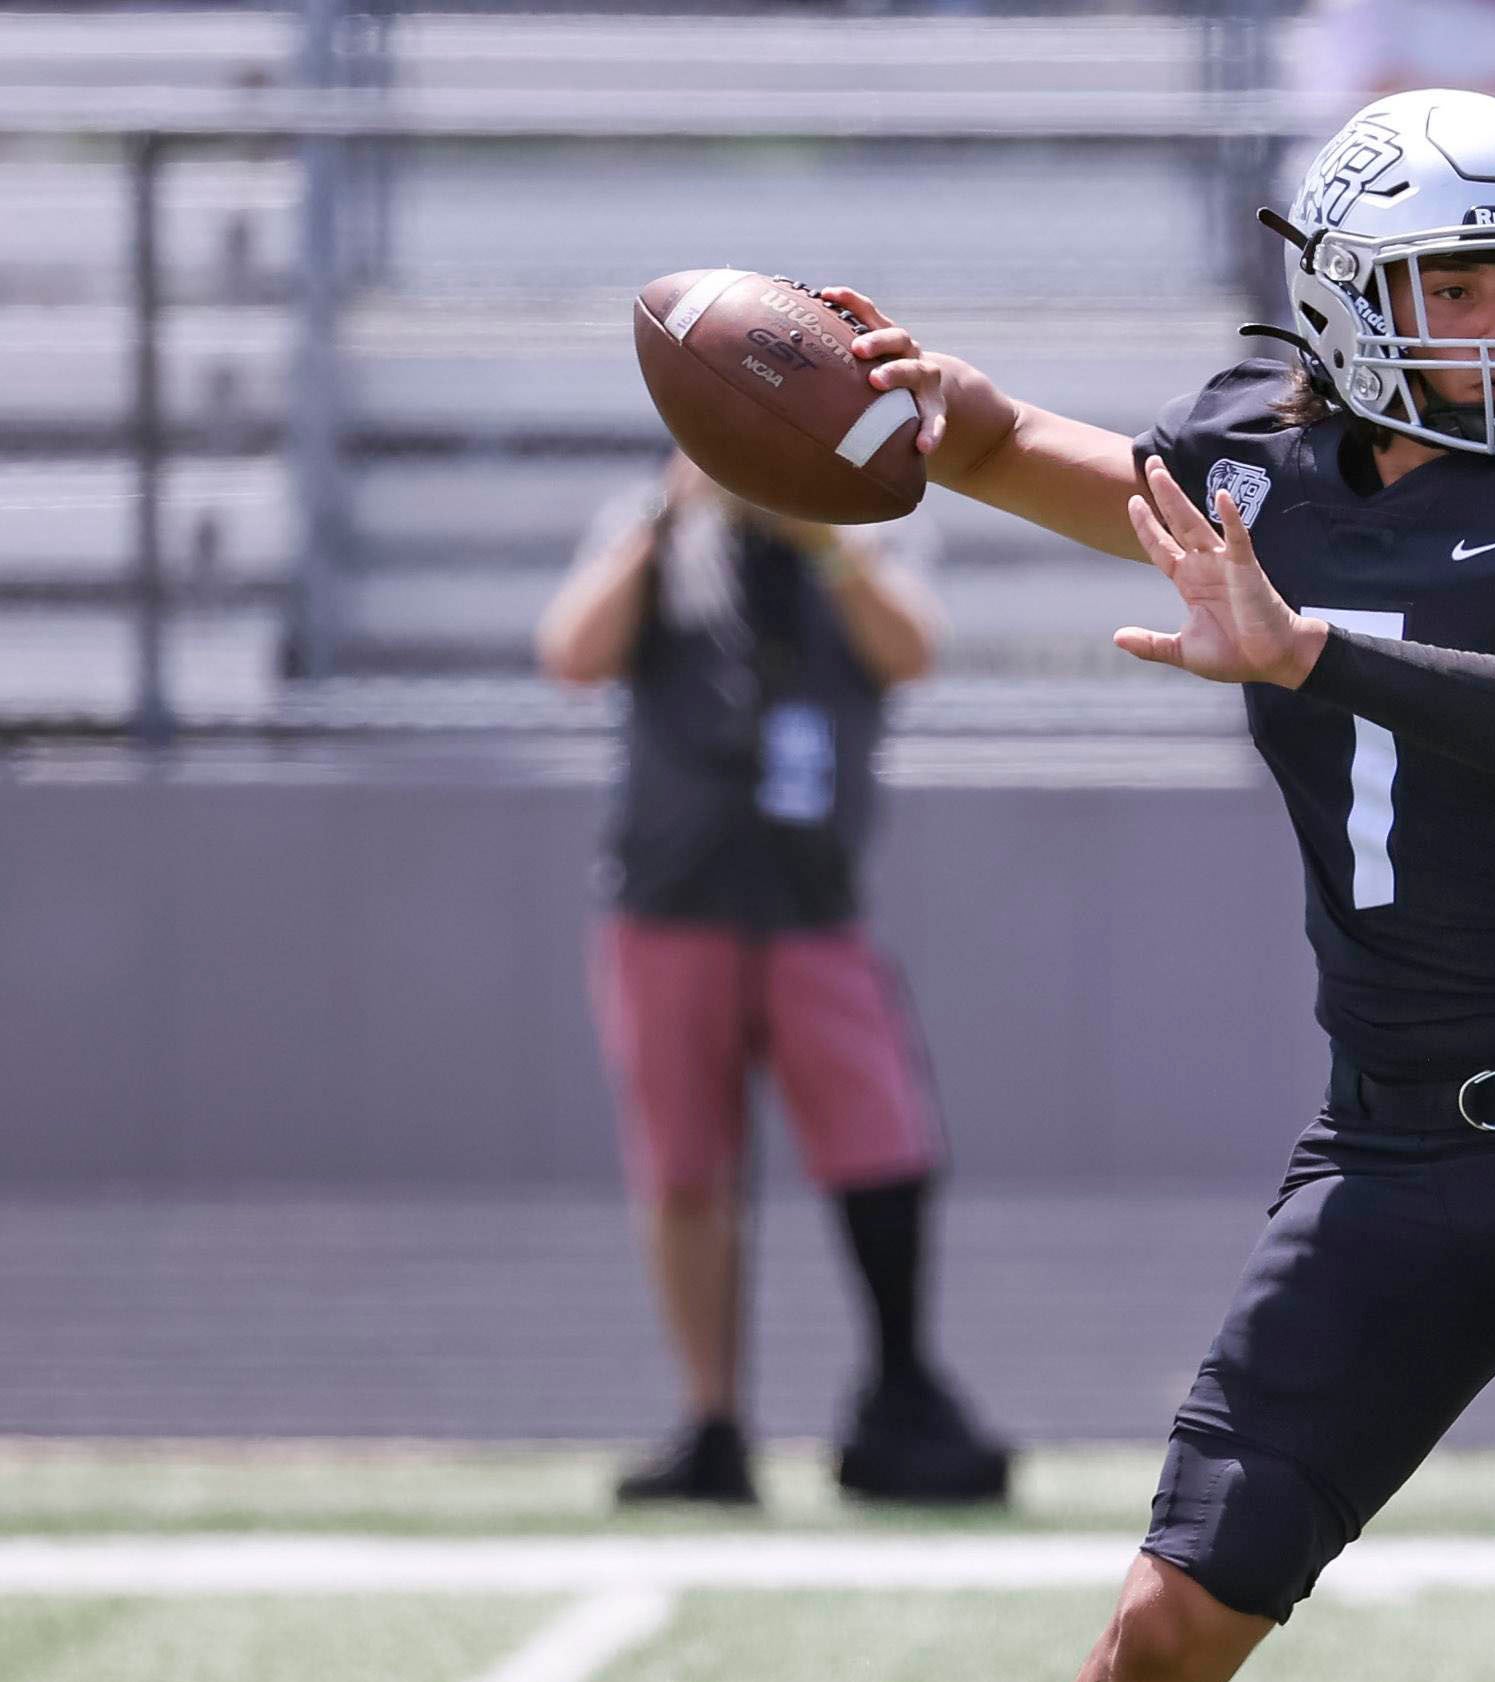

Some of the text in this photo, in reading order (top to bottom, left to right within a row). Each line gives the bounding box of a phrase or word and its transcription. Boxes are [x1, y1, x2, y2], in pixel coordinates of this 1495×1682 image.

[760, 287, 855, 364] Wilson
[1354, 296, 1386, 334] Ridd
[746, 328, 818, 369] GST
[741, 354, 784, 388] NCAA
